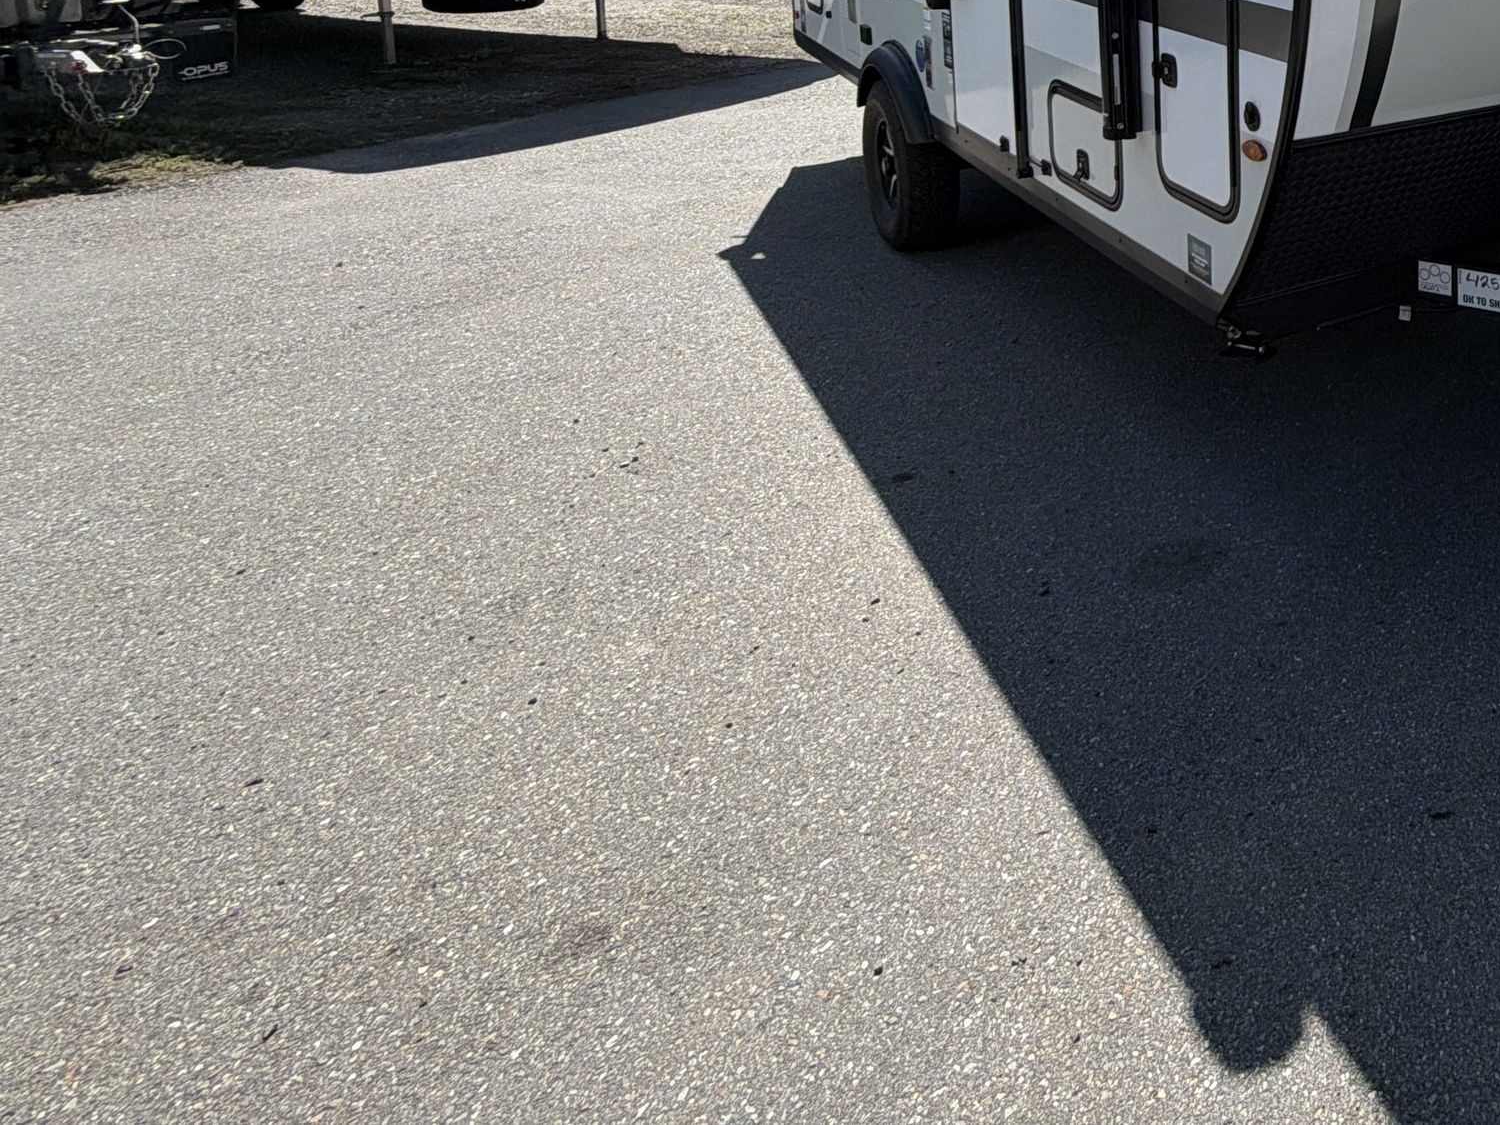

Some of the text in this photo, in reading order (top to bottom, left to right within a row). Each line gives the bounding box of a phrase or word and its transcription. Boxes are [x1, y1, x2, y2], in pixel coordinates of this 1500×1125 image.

[179, 61, 229, 76] OPUS
[1462, 294, 1475, 305] OK
[1476, 296, 1487, 307] TO
